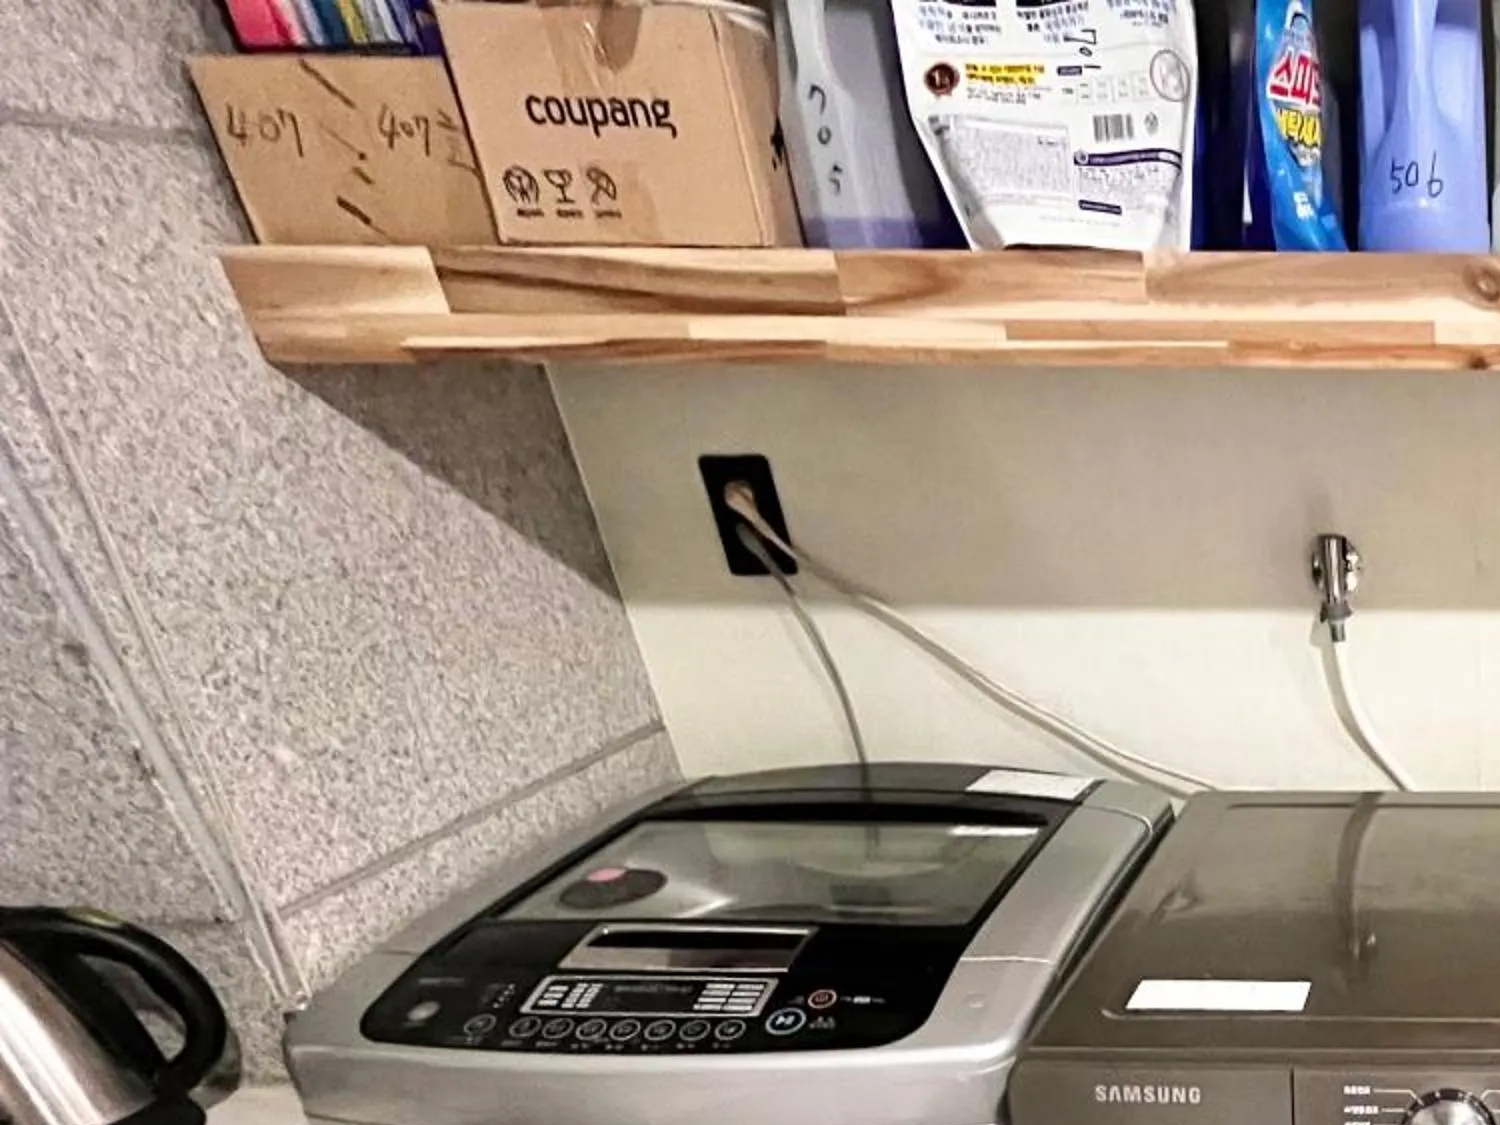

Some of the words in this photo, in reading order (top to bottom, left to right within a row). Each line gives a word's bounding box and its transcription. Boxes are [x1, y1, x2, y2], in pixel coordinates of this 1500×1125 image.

[225, 102, 304, 158] 407
[525, 94, 677, 139] coupang
[1390, 150, 1444, 198] 506
[1095, 1085, 1201, 1105] SAMSUNG
